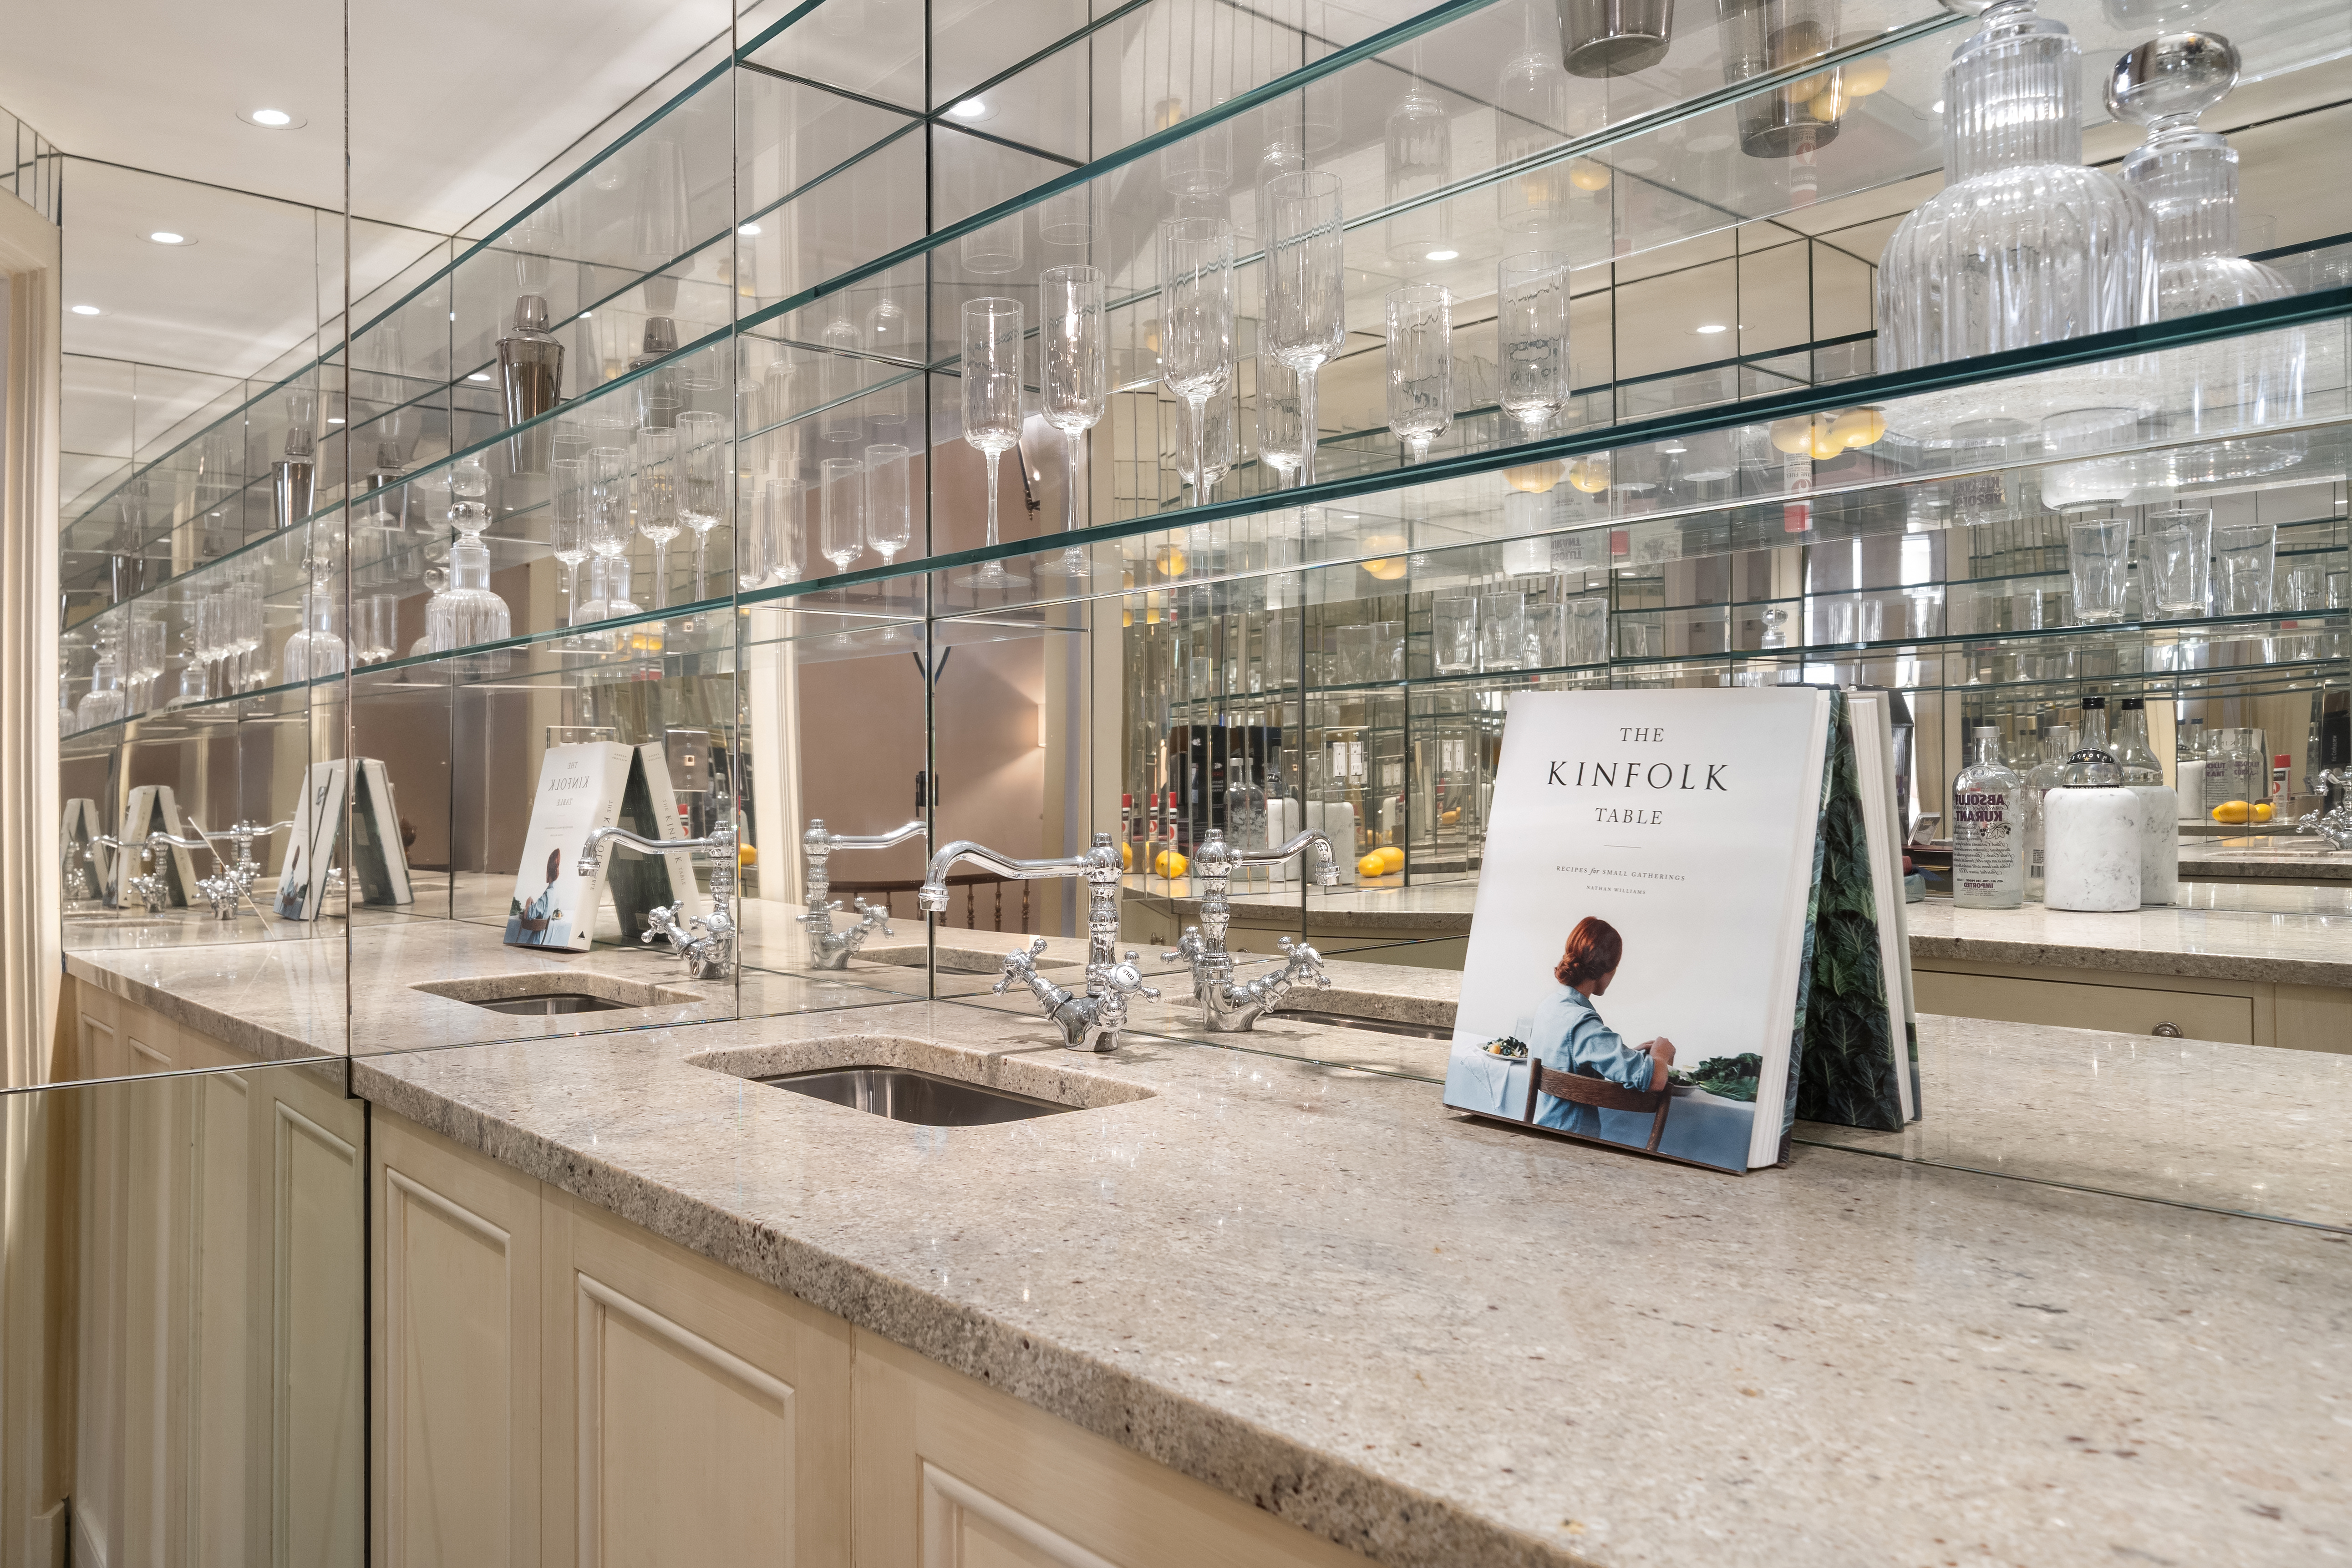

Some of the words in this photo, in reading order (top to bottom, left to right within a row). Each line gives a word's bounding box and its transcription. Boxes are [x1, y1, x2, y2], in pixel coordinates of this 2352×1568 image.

[1620, 727, 1665, 742] THE
[1547, 761, 1729, 791] KINFOLK
[1595, 808, 1663, 825] TABLE
[1588, 867, 1600, 876] for
[1631, 871, 1686, 882] GATHERINGS
